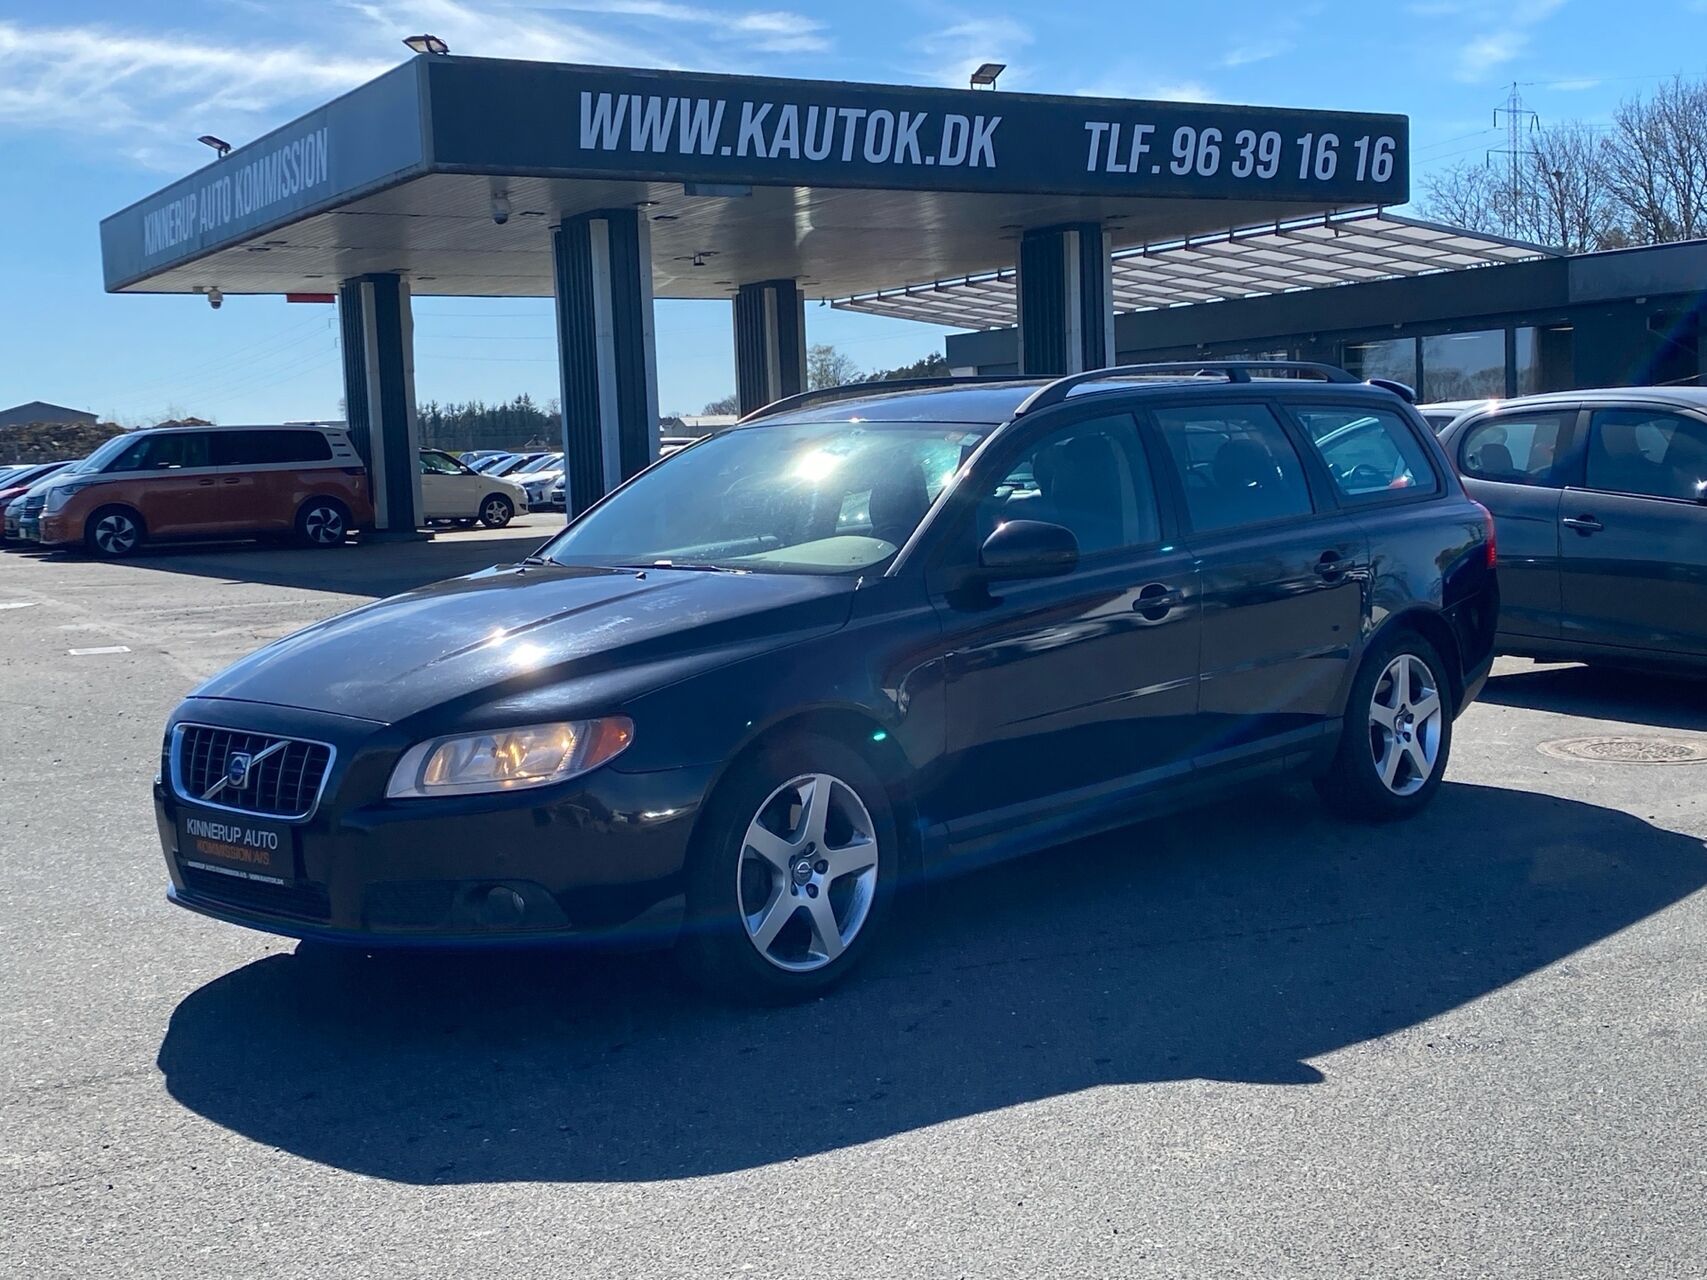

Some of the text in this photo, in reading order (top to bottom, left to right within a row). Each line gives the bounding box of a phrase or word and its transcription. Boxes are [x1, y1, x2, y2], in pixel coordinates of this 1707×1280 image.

[579, 91, 1002, 168] WWW.KAUTOK.DK
[1084, 121, 1396, 183] TLF. 96 39 16 16
[144, 127, 328, 256] KINNERUP AUTO KOMMISSION
[186, 818, 278, 850] KINNERUP AUTO
